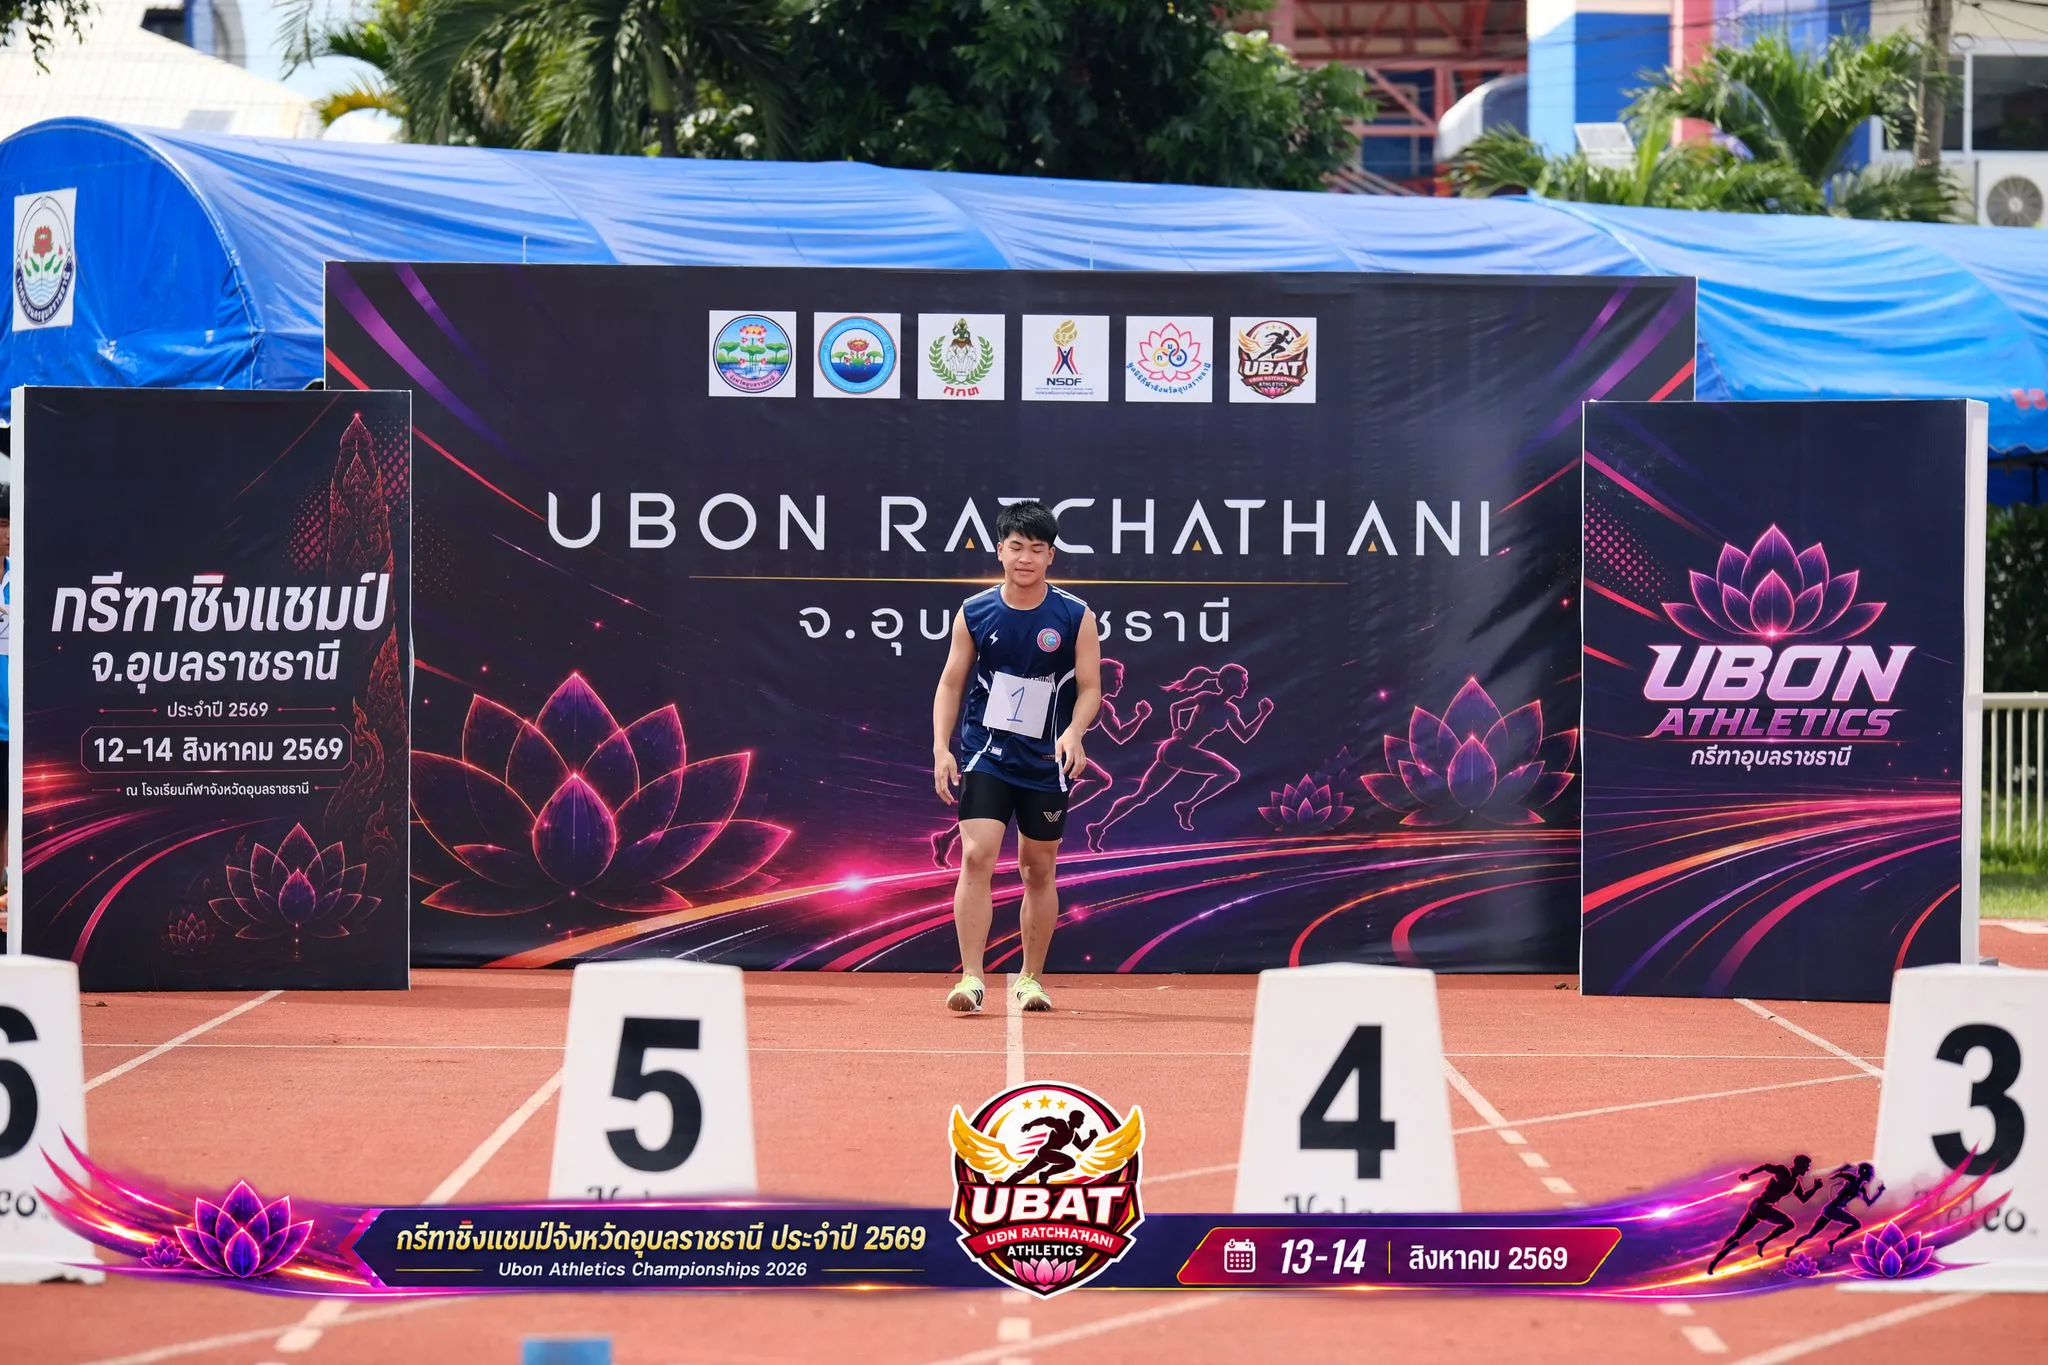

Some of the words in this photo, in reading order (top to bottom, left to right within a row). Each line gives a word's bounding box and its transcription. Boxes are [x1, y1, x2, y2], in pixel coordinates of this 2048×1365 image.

[1046, 377, 1083, 386] NSDF
[1243, 361, 1303, 376] UBAT
[943, 386, 980, 397] กกท
[548, 491, 826, 550] UBON
[880, 496, 1490, 557] RACHATHANI
[51, 571, 390, 632] กรีฑาชิงแชมป์
[91, 639, 341, 694] จ.อุบลราชธานี
[1643, 644, 1917, 702] UBON
[167, 700, 222, 718] ประจำปี
[228, 702, 269, 718] 2569
[1006, 686, 1024, 723] 1
[1643, 707, 1908, 739] ATHLETICS
[94, 737, 173, 763] 12-14
[182, 736, 273, 762] สิงหาคม
[282, 737, 344, 761] 2569
[1690, 744, 1853, 772] กรีฑาอุบลราชธานี
[126, 786, 138, 797] ณ
[606, 1017, 703, 1172] 5
[1300, 1025, 1396, 1179] 4
[1931, 1023, 2025, 1176] 3
